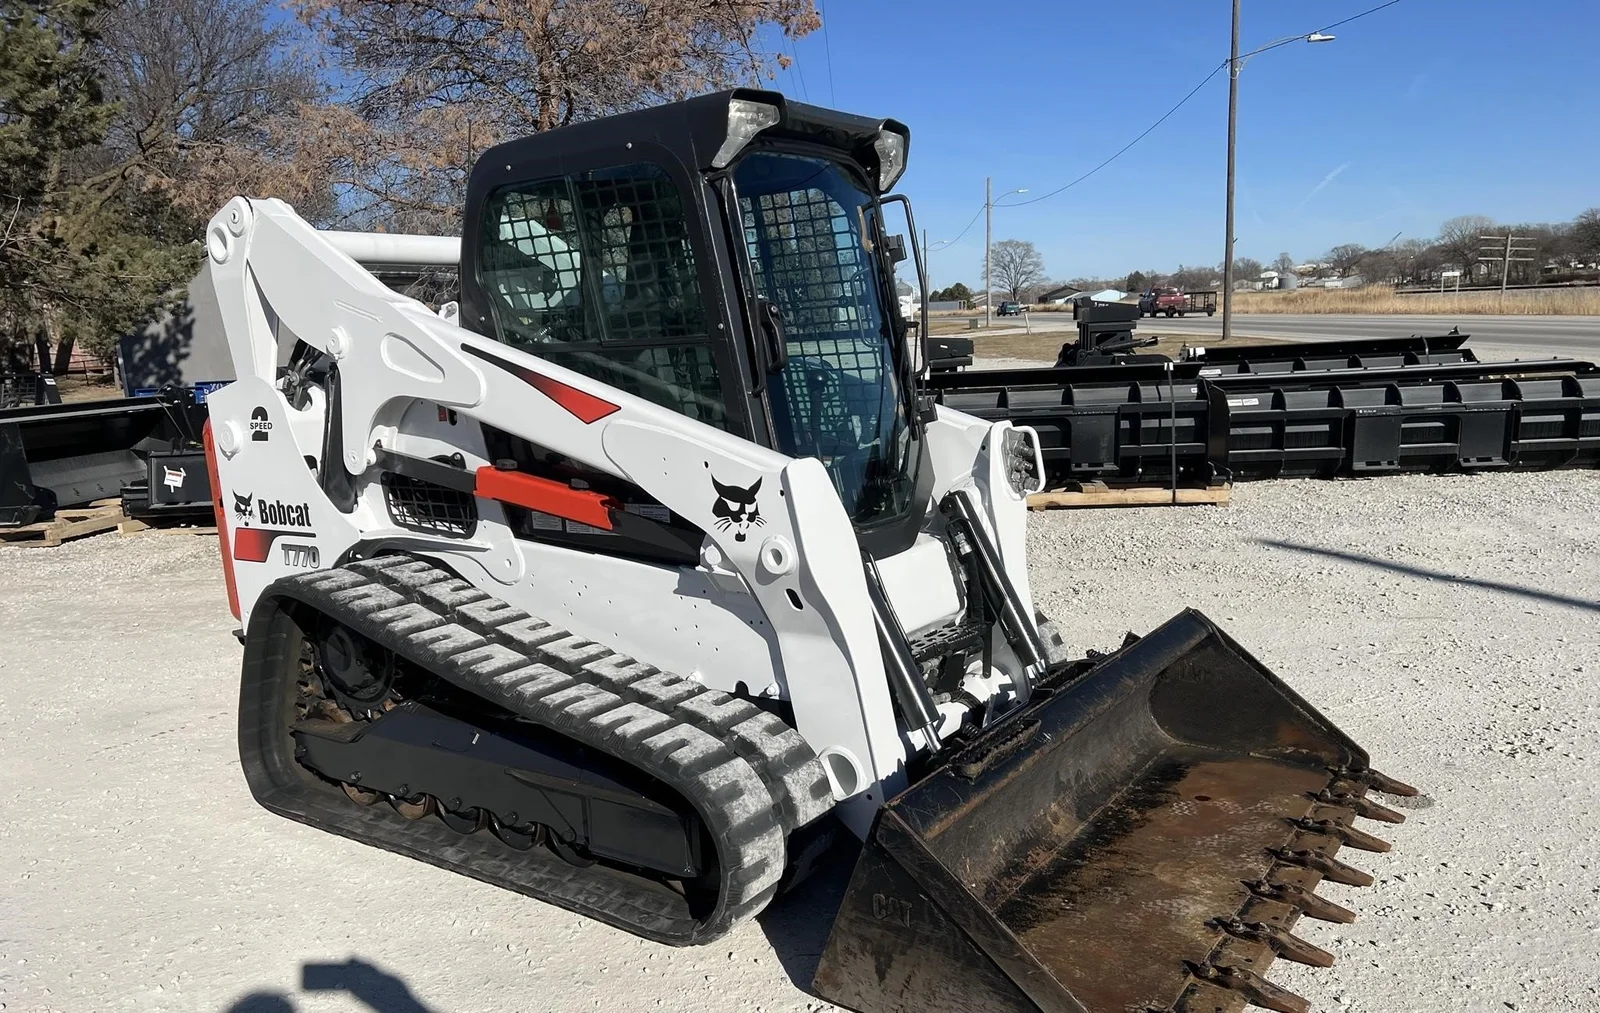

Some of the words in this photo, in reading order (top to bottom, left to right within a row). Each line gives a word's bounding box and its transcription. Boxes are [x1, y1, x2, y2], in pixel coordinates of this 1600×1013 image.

[250, 421, 273, 431] SPEED
[251, 405, 269, 442] 2
[257, 499, 312, 527] Bobcat
[281, 543, 321, 569] T770
